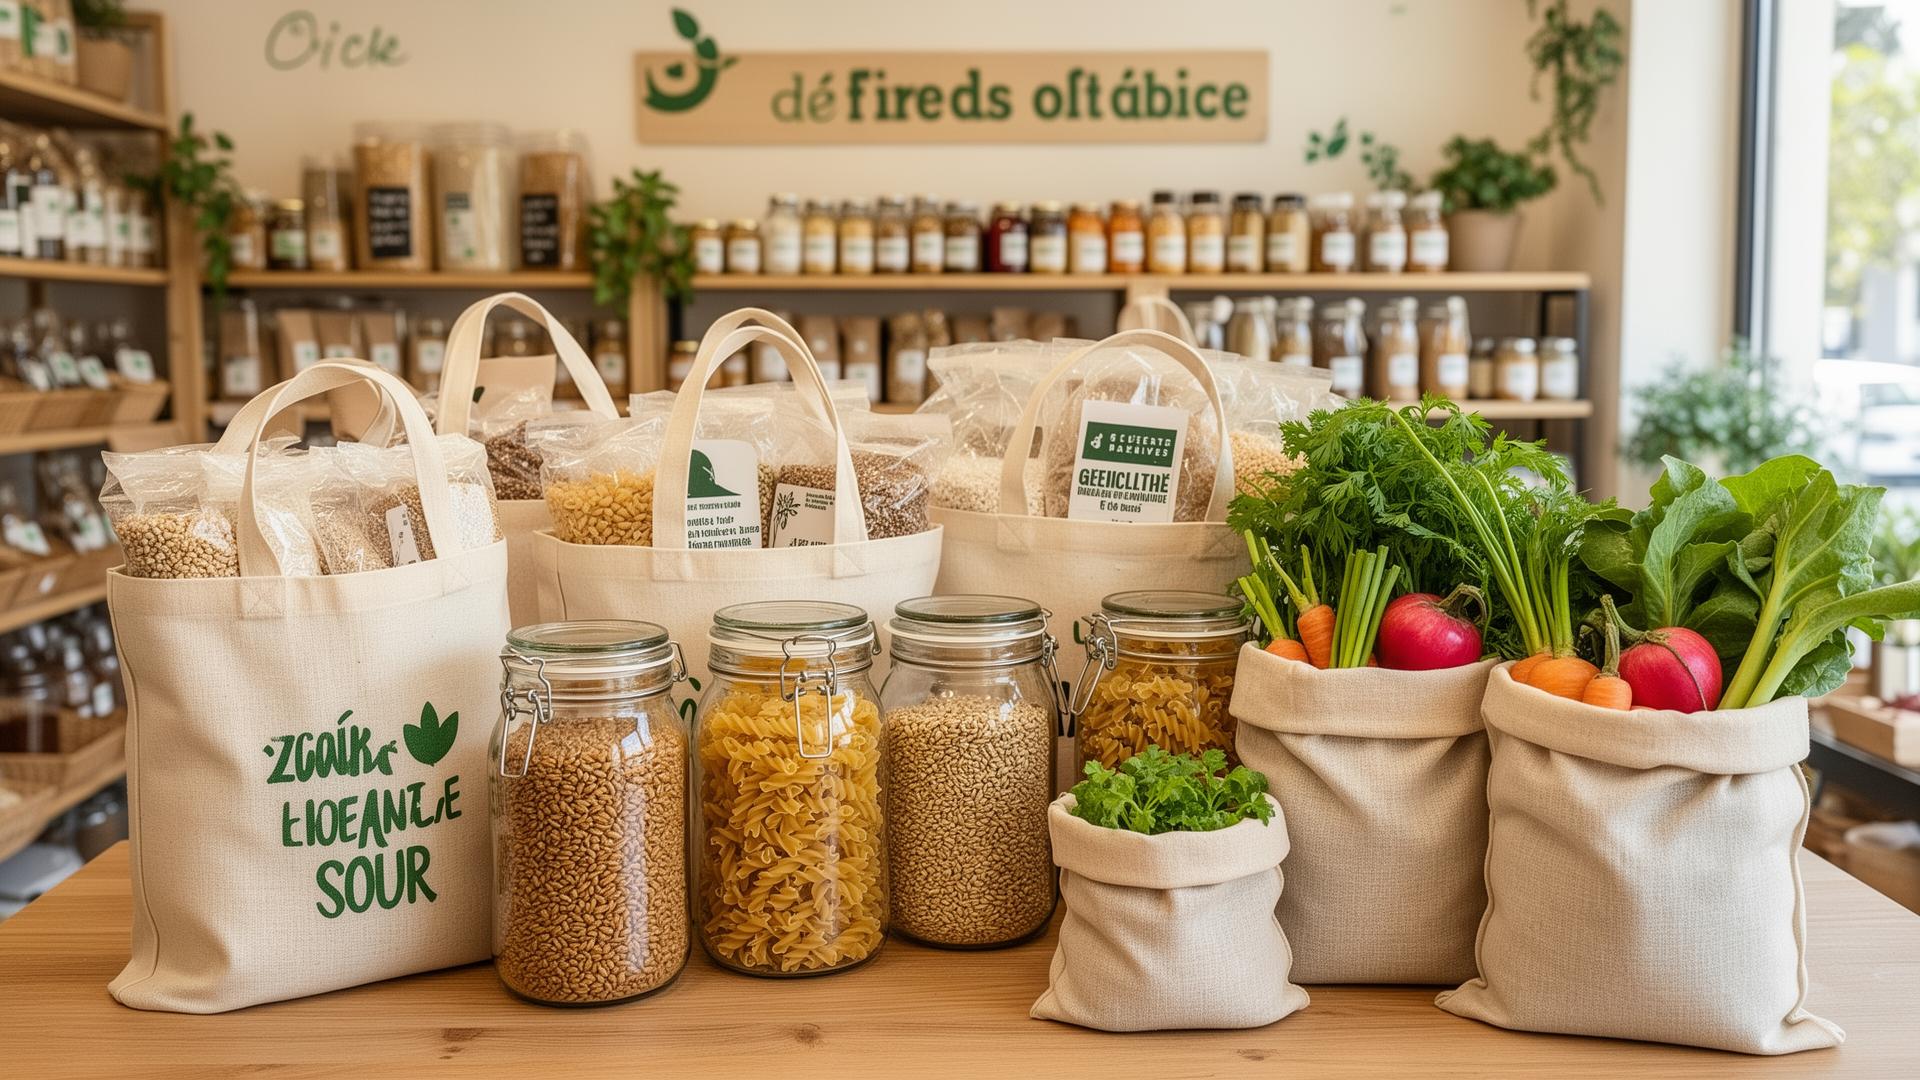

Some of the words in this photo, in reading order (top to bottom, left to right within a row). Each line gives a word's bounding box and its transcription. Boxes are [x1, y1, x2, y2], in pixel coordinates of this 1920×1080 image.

[771, 72, 835, 123] dé
[847, 67, 1013, 123] fireds
[316, 845, 438, 919] SOUR
